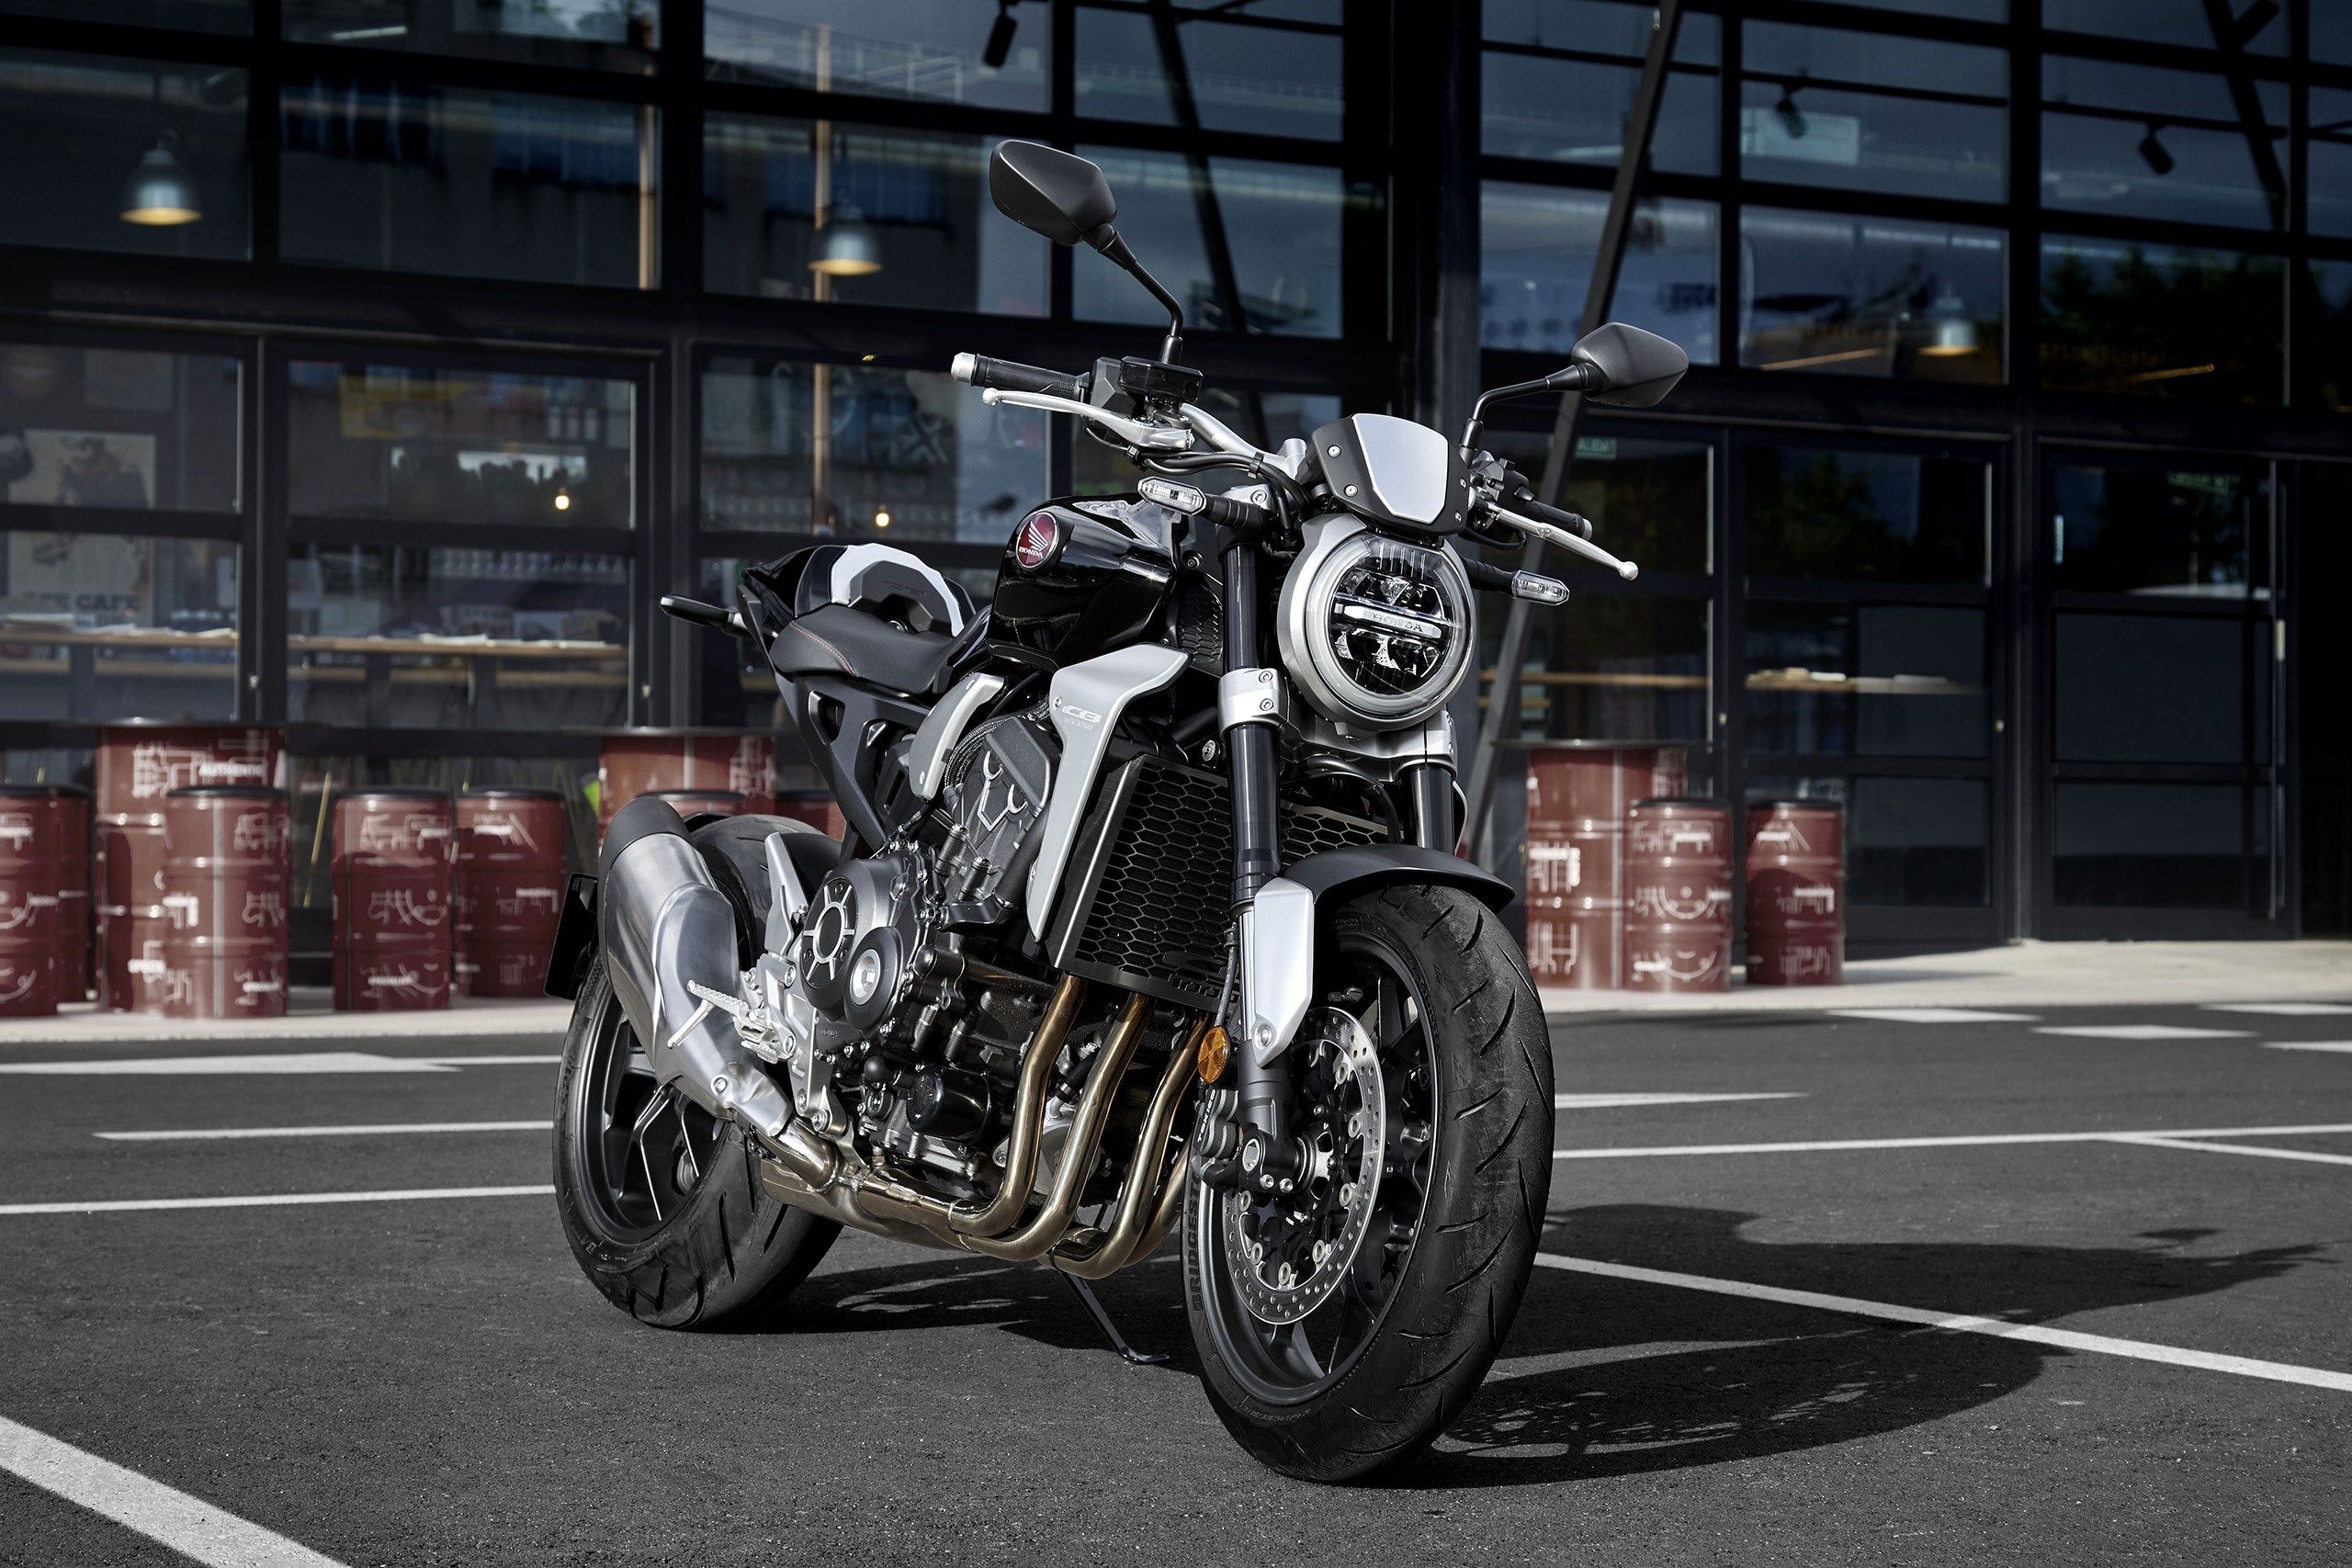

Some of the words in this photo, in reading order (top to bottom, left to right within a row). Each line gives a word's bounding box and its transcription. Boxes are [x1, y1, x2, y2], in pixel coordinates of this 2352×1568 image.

[1018, 546, 1044, 559] HONDA
[1370, 611, 1424, 633] HONDA
[1061, 705, 1102, 723] CB
[1197, 1089, 1216, 1143] TOKICO
